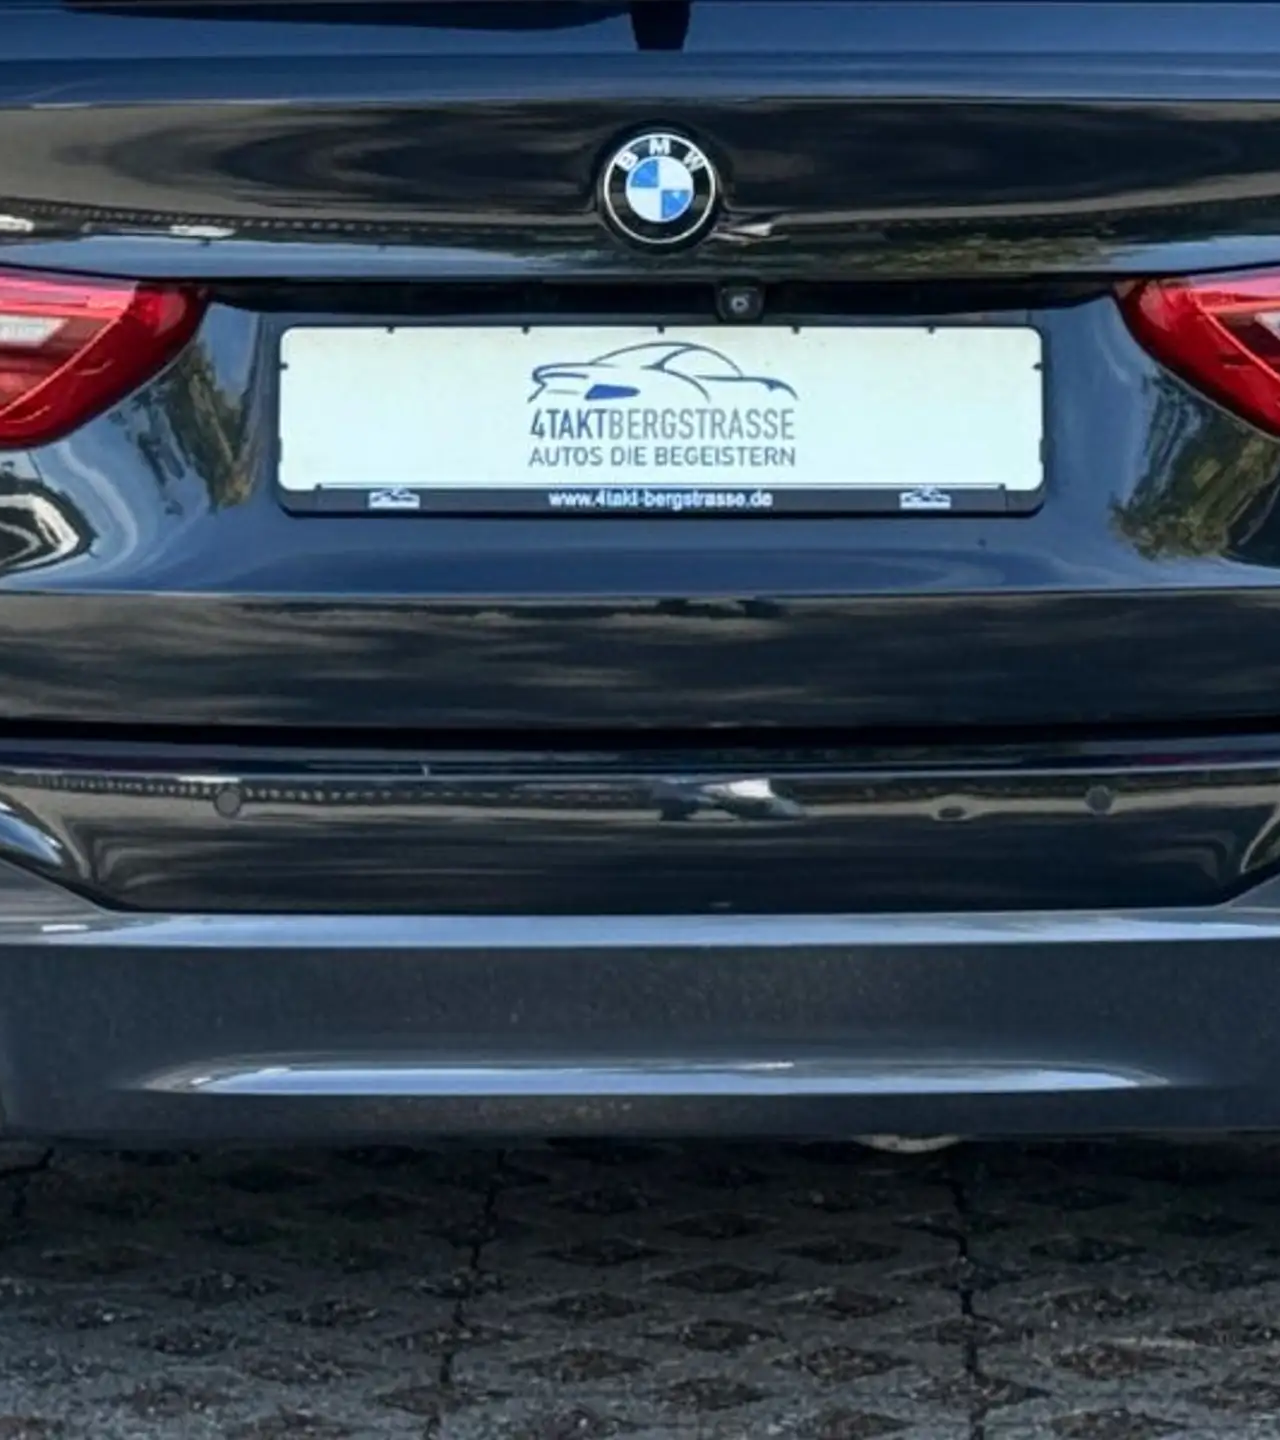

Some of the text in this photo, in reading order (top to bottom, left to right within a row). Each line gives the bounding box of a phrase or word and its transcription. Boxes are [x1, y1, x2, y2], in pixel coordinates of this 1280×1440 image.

[613, 136, 705, 172] BMW
[530, 408, 796, 441] 4TAKTBERGSTRASSE
[527, 446, 796, 467] AUTOS DIE BEGEISTERN
[548, 490, 773, 510] www.4takt-bergstrasse.de
